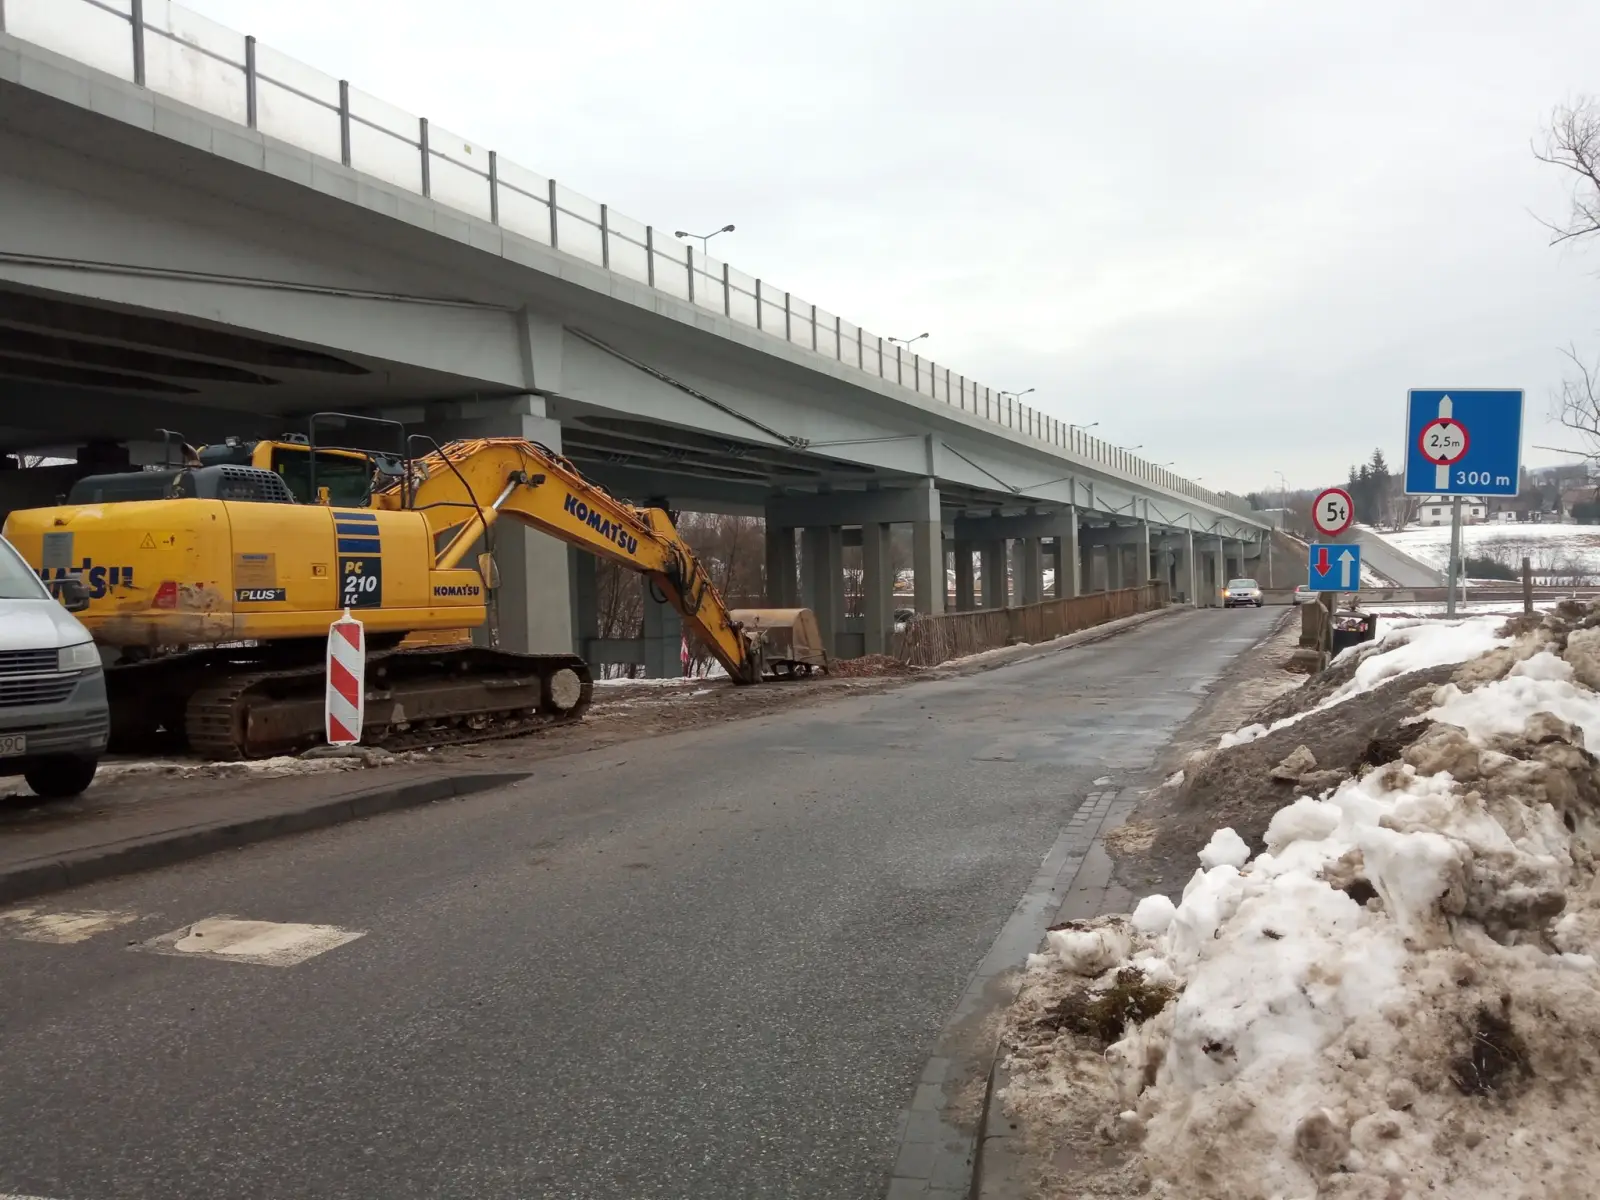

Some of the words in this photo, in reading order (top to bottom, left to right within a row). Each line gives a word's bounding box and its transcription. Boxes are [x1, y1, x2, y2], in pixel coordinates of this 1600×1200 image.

[1456, 471, 1491, 486] 300
[1495, 475, 1510, 486] m
[563, 492, 638, 555] KOMATSU
[344, 561, 363, 574] PC
[344, 575, 377, 592] 210
[433, 584, 480, 596] KOMATSU
[344, 594, 359, 605] LC
